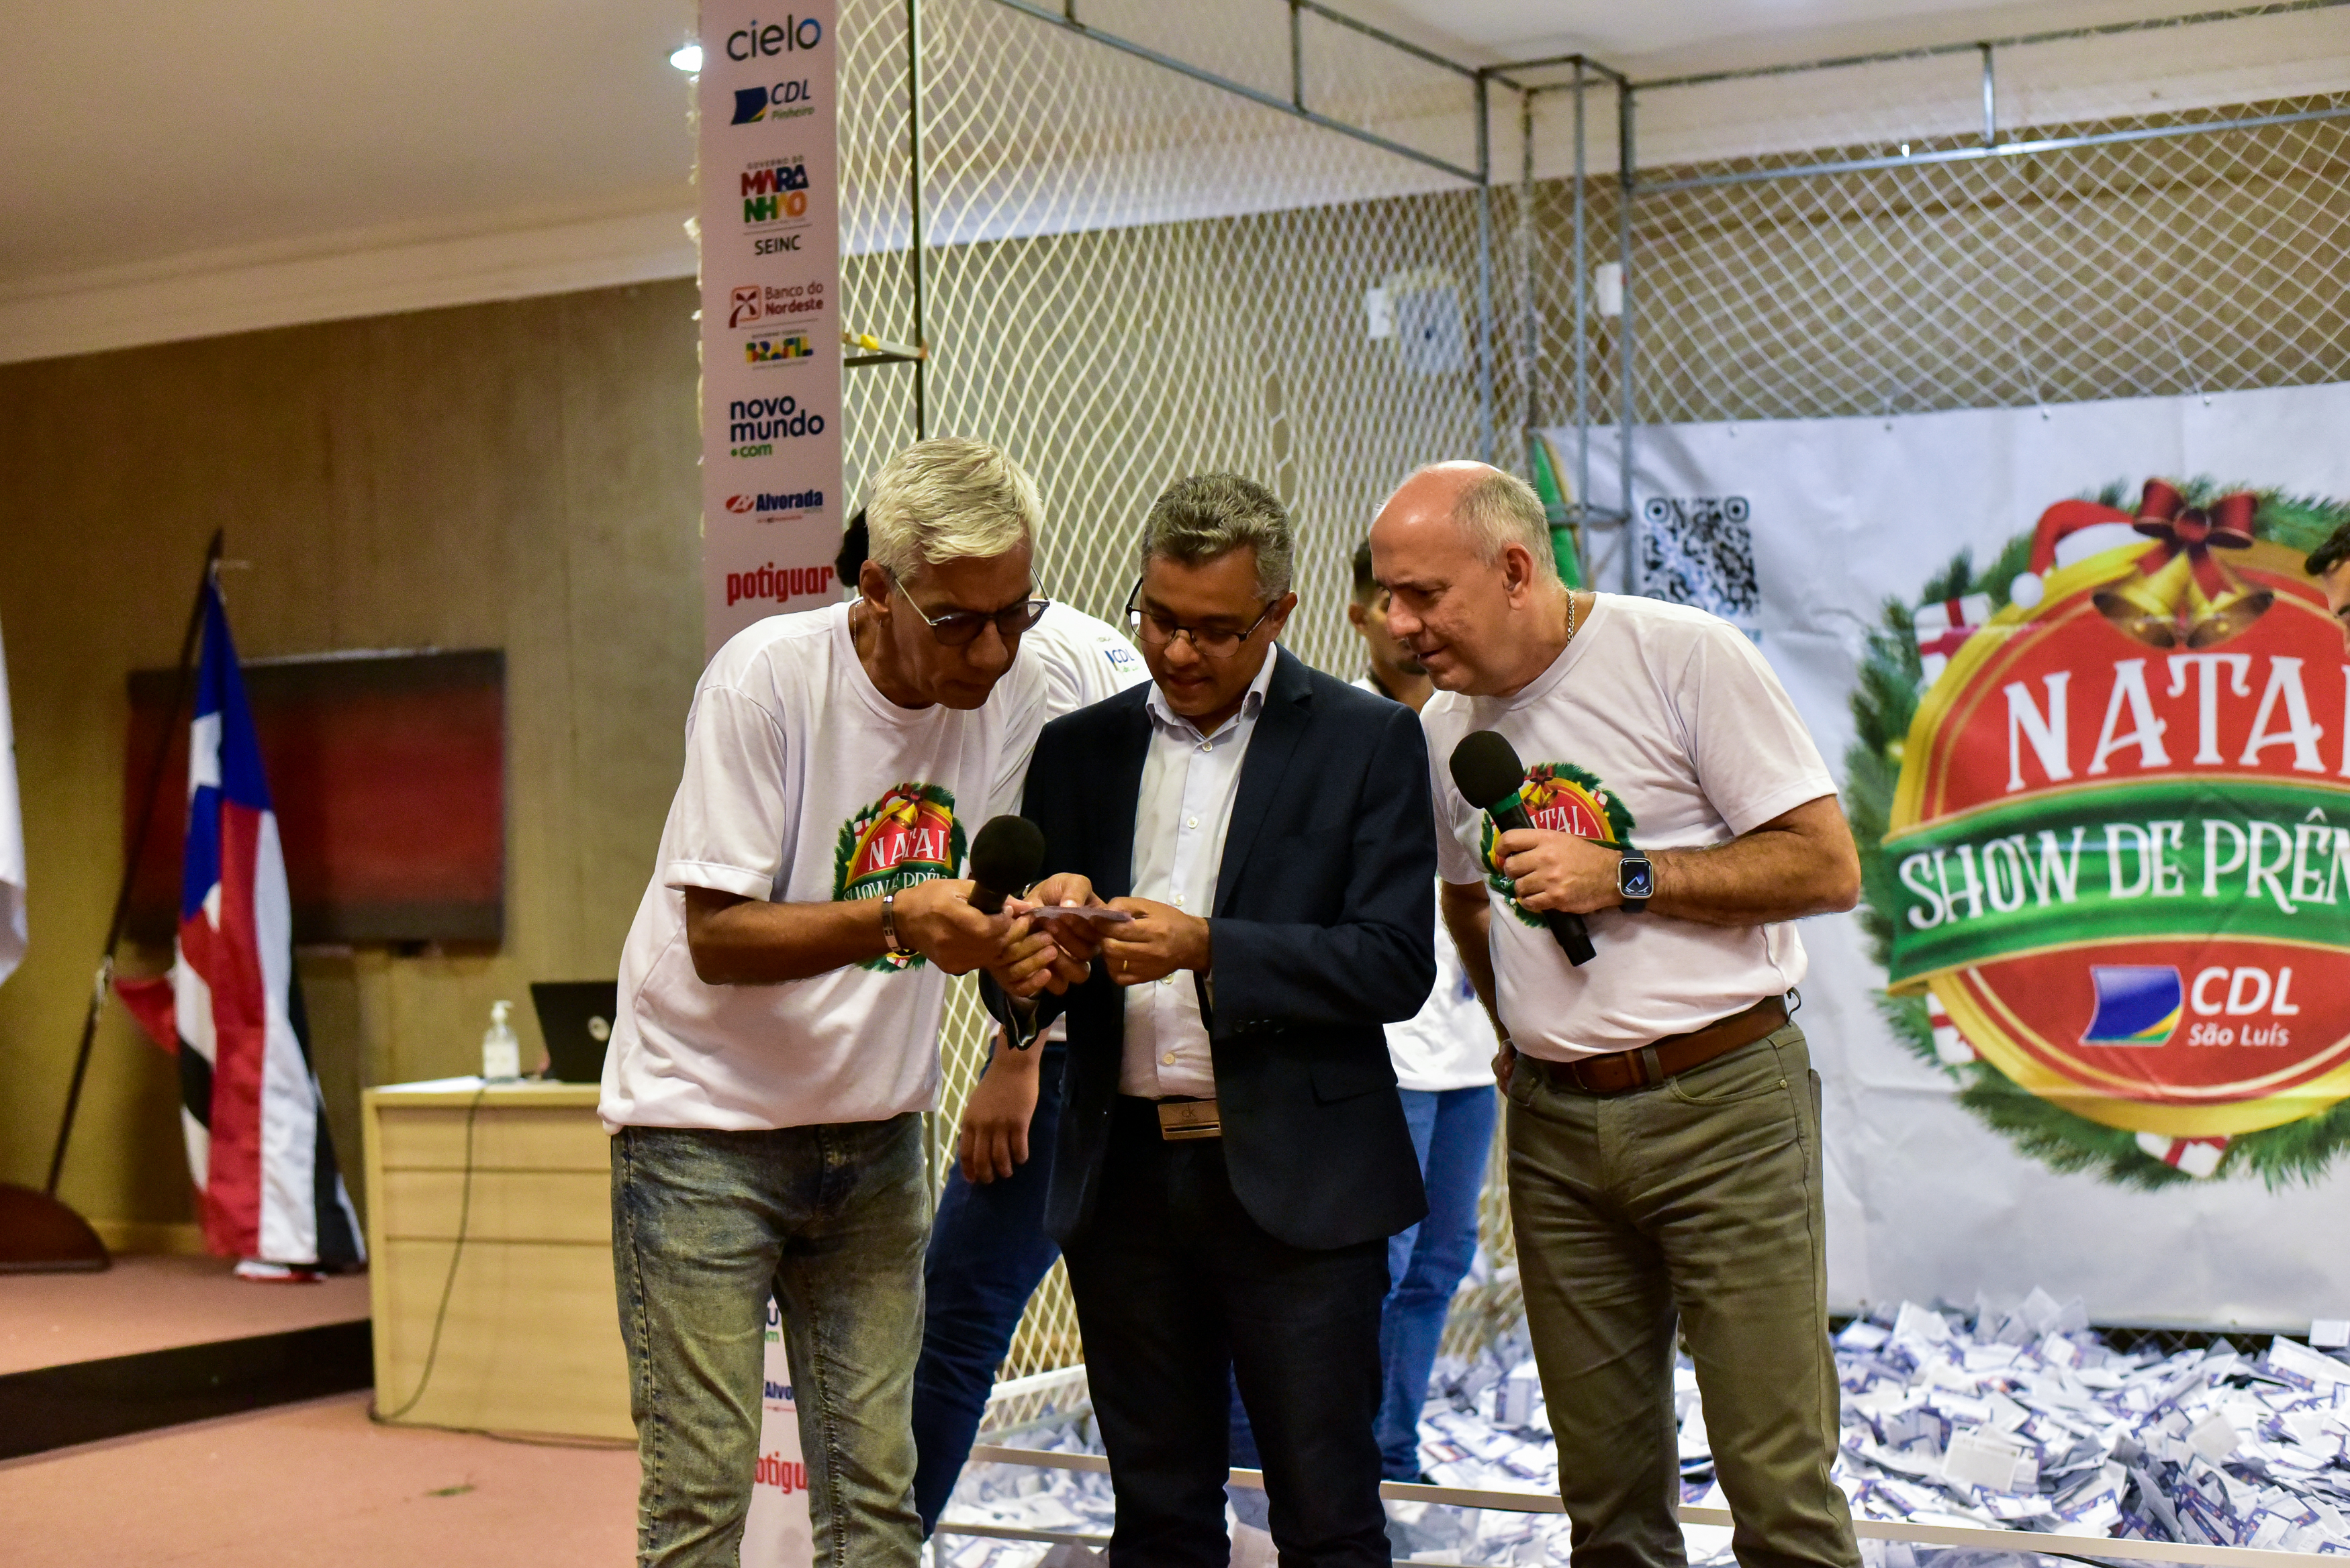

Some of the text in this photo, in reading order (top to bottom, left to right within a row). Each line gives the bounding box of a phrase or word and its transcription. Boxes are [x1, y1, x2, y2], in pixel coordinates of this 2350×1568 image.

[726, 14, 821, 61] cielo
[771, 79, 810, 105] CDL
[755, 235, 800, 255] SEINC
[765, 281, 823, 300] Banco do
[765, 298, 824, 315] Nordeste
[731, 396, 796, 420] novo
[731, 409, 825, 442] mundo
[756, 489, 823, 511] Alvorada
[727, 562, 834, 606] potiguar
[1112, 649, 1135, 664] CDL
[2004, 654, 2350, 792] NATA
[1530, 805, 1587, 836] TAL
[1899, 827, 2085, 930] SHOW
[2104, 821, 2185, 899] DE
[2190, 966, 2300, 1016] CDL
[2188, 1022, 2290, 1046] São Luís
